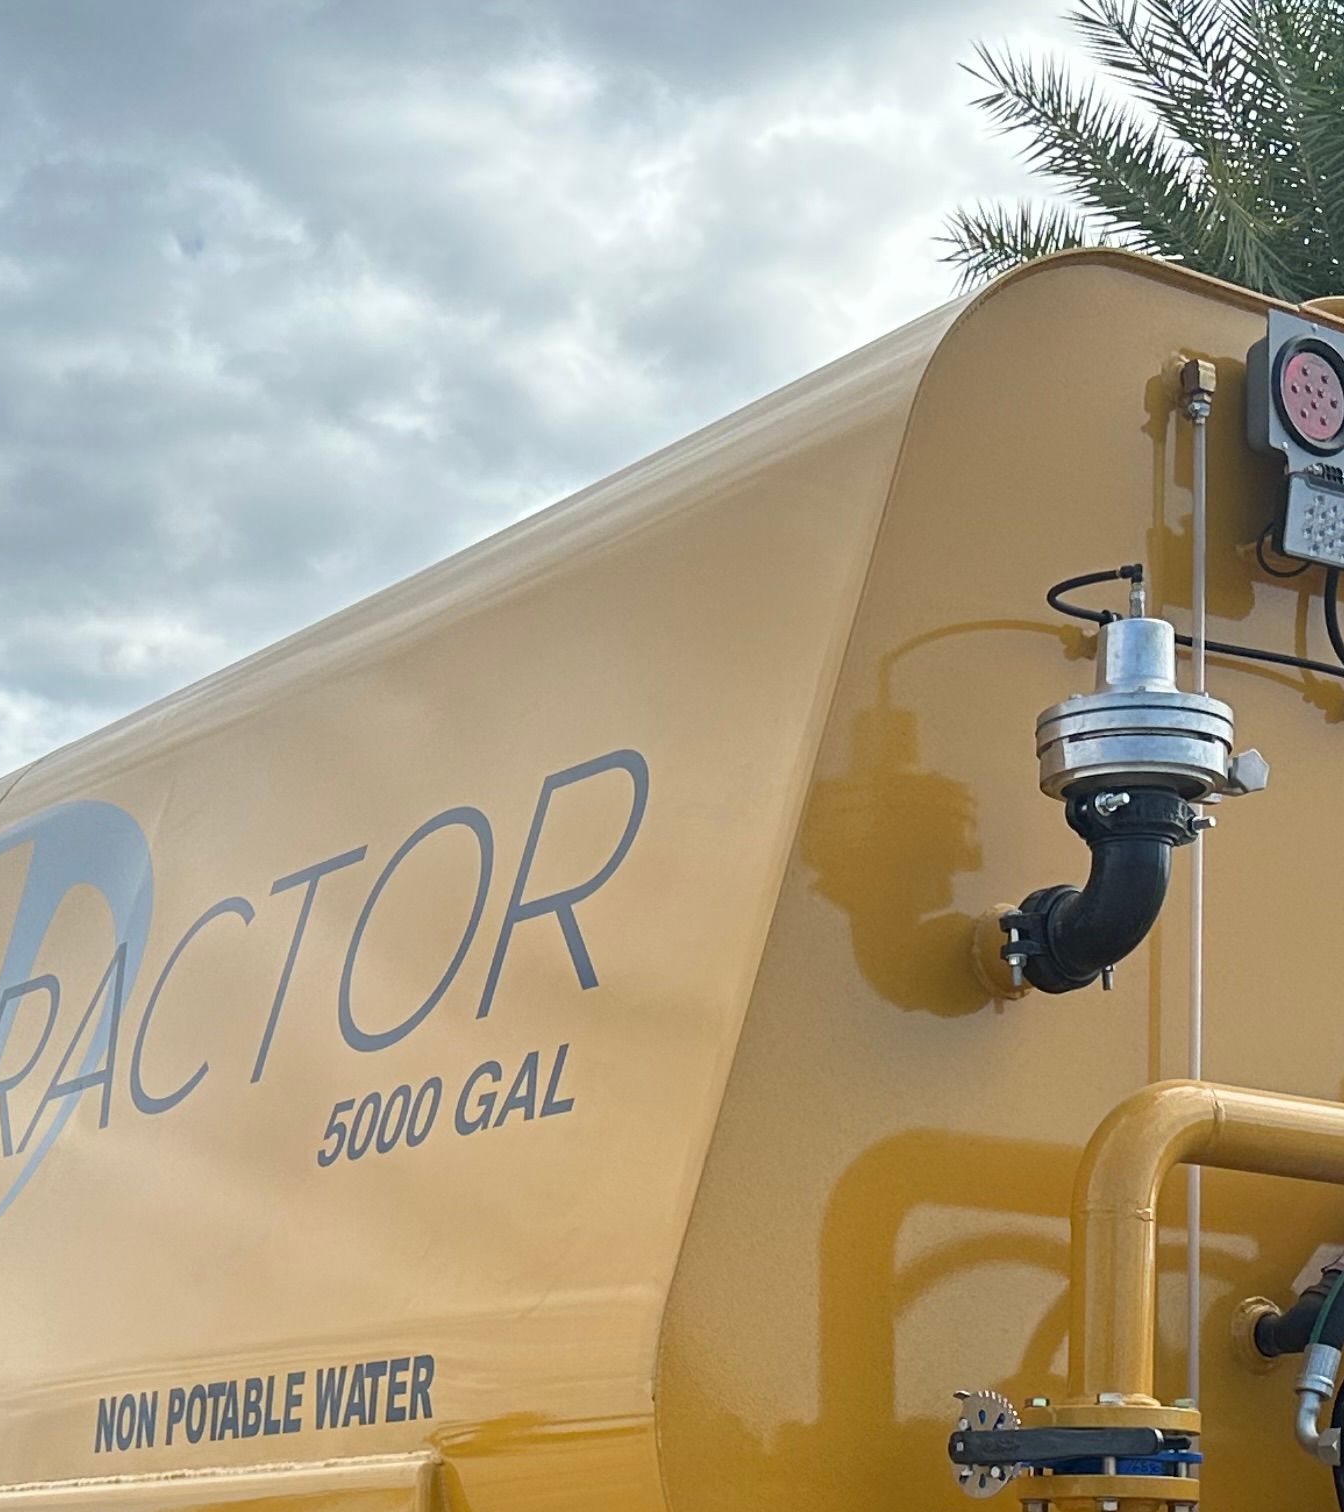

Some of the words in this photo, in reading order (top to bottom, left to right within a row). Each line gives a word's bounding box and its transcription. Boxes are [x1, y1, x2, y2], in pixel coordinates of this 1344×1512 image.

[317, 1076, 443, 1168] 5000
[454, 1043, 575, 1136] GAL
[94, 1390, 158, 1453] NON
[165, 1371, 306, 1446] POTABLE
[315, 1354, 435, 1430] WATER
